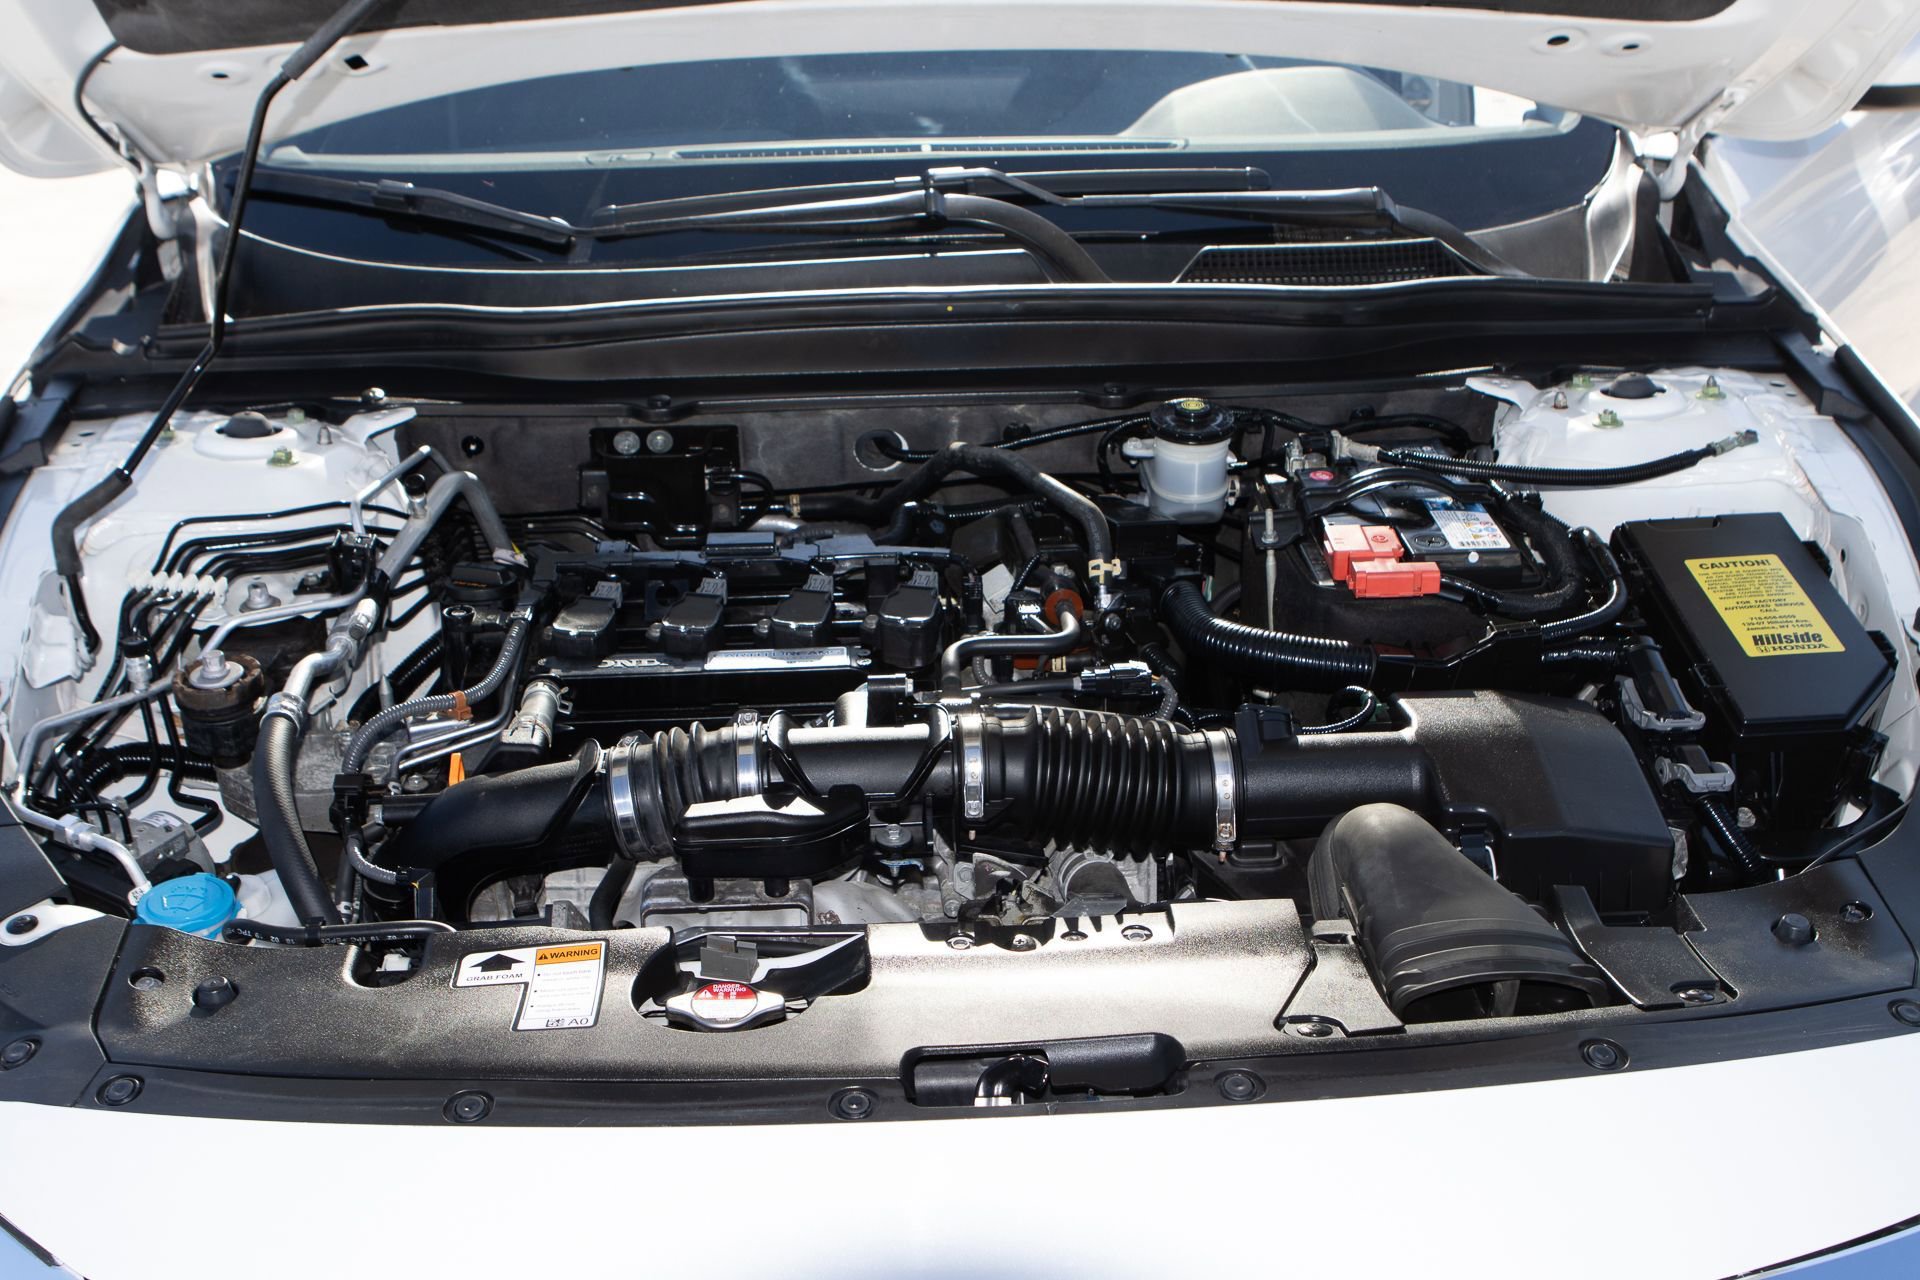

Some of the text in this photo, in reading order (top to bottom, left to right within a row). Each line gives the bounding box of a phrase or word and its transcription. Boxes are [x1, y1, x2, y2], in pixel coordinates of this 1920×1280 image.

[1698, 559, 1771, 569] CAUTION!
[1752, 631, 1823, 647] Hillside
[1772, 644, 1830, 652] HONDA
[549, 948, 598, 959] WARNING
